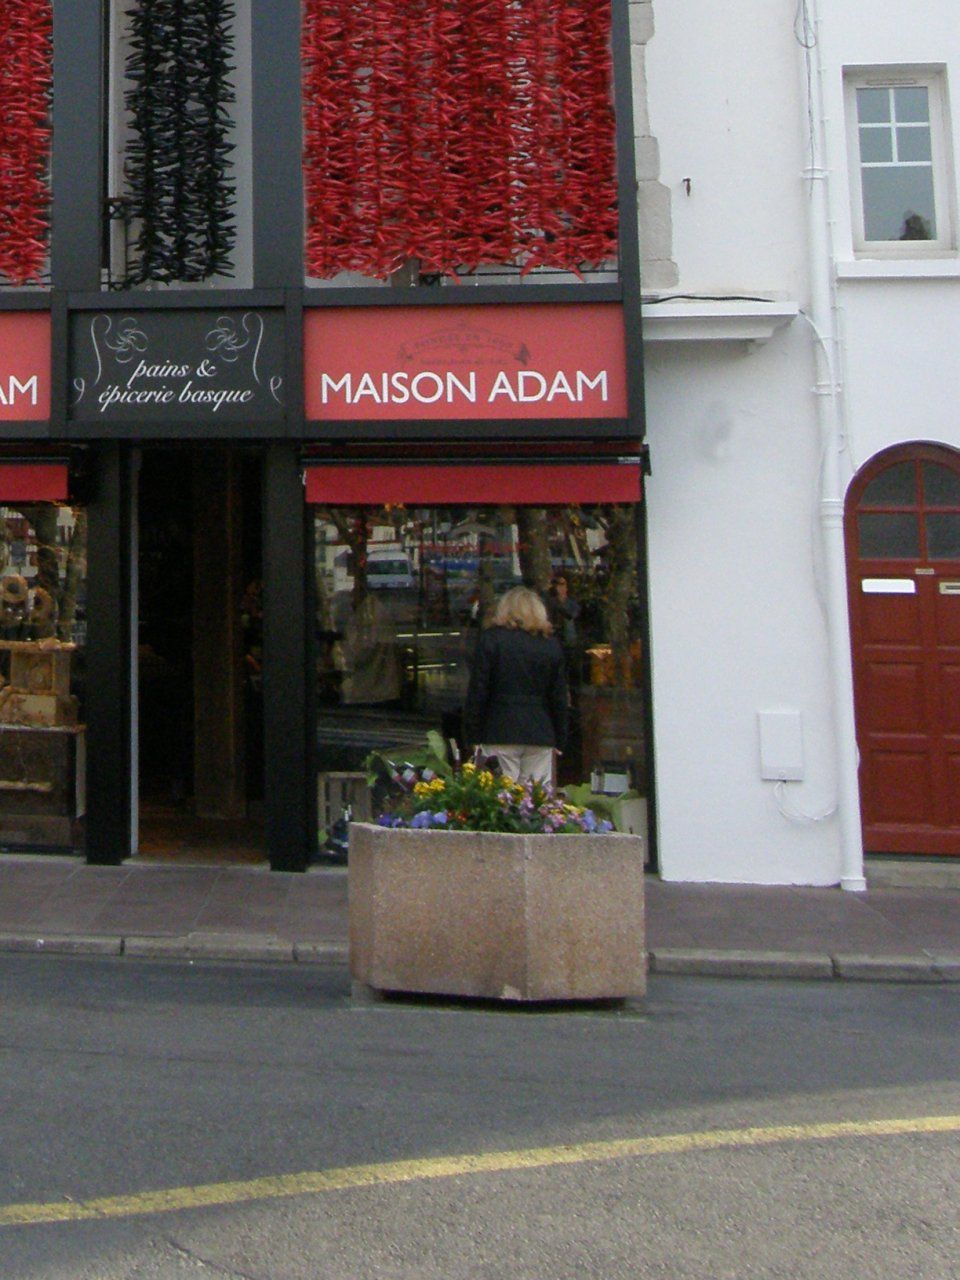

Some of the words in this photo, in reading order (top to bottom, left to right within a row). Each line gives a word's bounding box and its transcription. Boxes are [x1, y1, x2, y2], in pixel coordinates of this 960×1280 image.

[127, 358, 190, 387] pains
[196, 358, 217, 378] &
[321, 371, 476, 404] MAISON
[487, 370, 608, 403] ADAM
[98, 384, 176, 413] épicerie
[178, 380, 255, 413] basque
